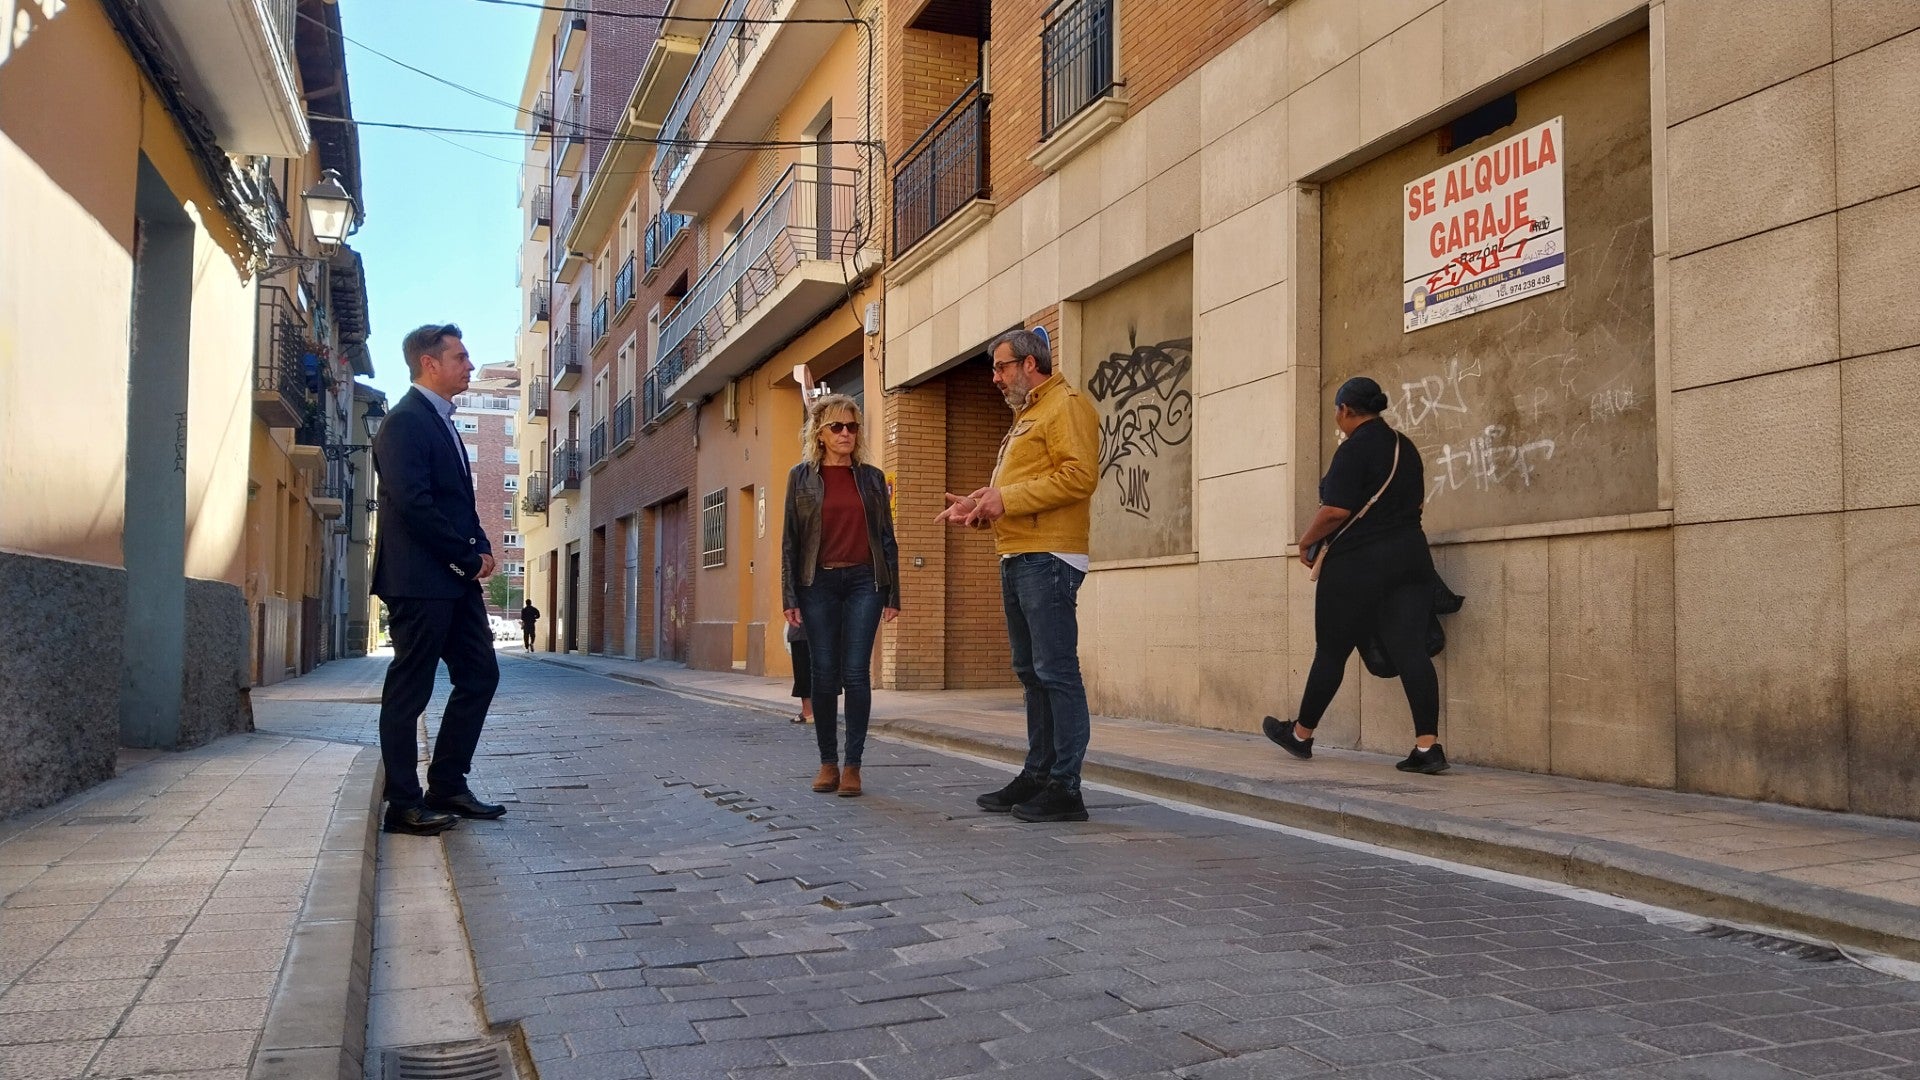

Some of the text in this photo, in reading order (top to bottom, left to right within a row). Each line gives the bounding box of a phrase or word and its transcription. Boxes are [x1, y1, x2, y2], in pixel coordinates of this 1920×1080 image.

[1408, 127, 1556, 221] SE ALQUILA
[1429, 188, 1529, 259] GARAJE
[1460, 242, 1498, 264] Razón
[1436, 279, 1487, 302] INMOBILIARIA
[1508, 267, 1525, 278] S.A.
[1509, 283, 1522, 294] 974
[1522, 278, 1536, 290] 238
[1536, 274, 1551, 285] 438
